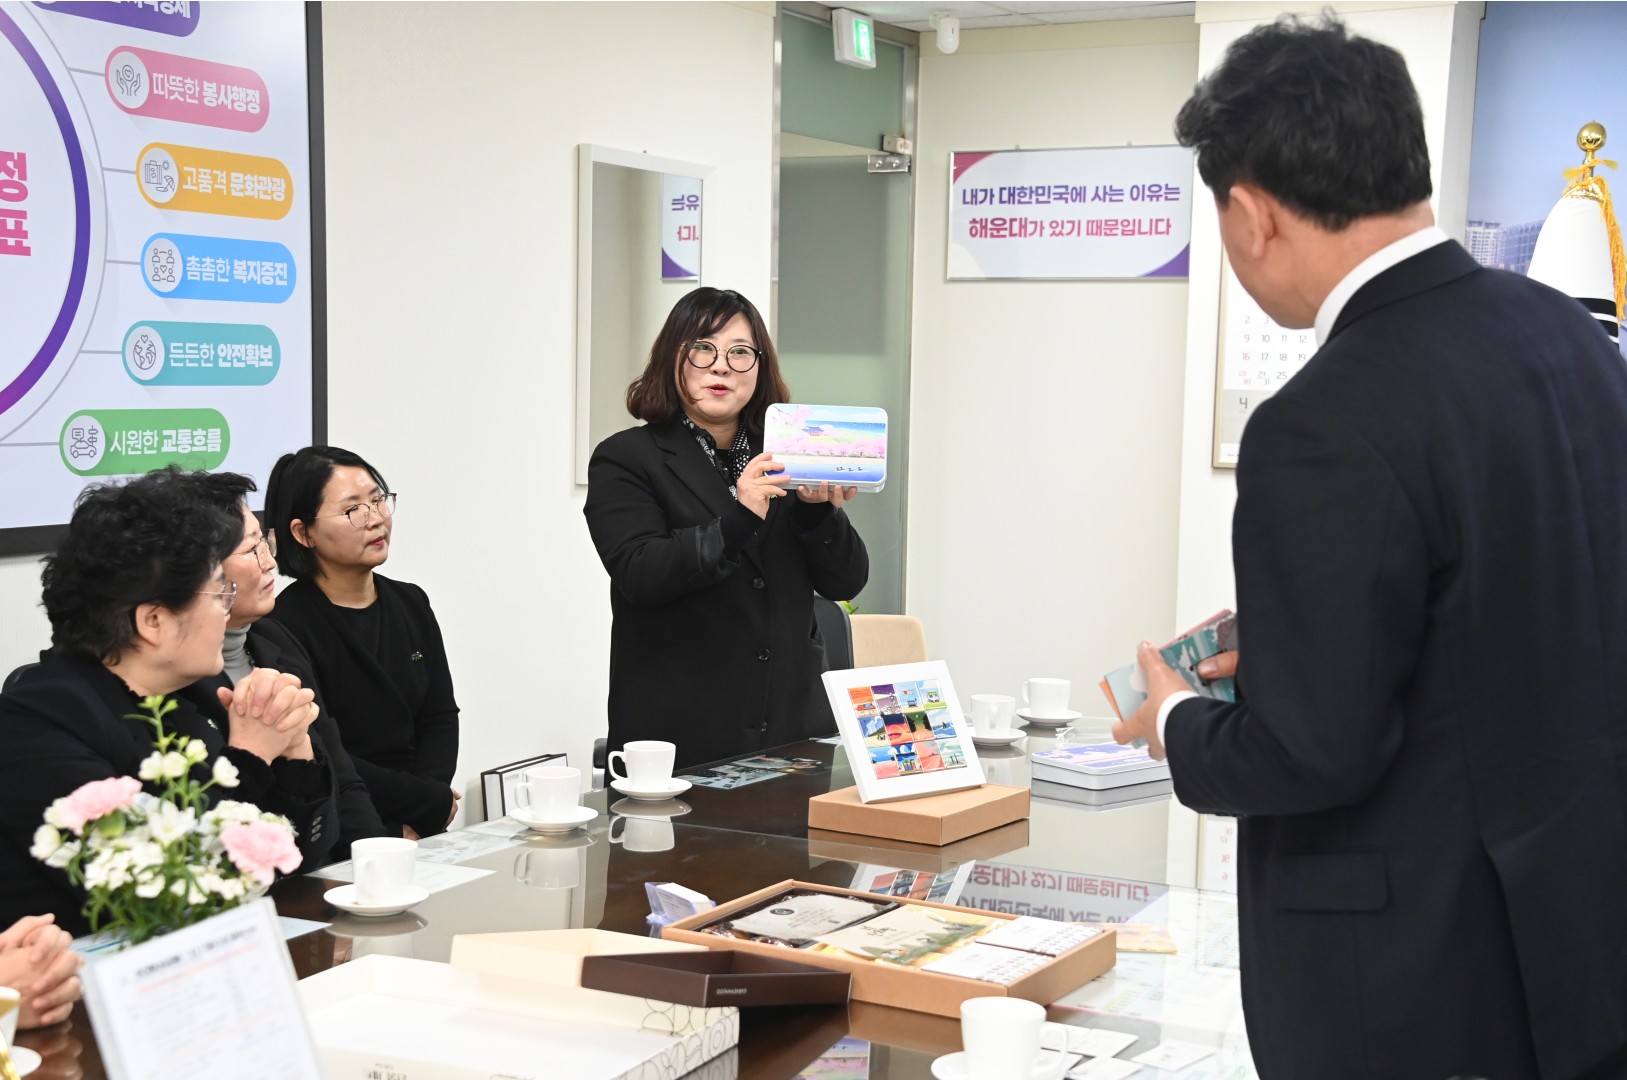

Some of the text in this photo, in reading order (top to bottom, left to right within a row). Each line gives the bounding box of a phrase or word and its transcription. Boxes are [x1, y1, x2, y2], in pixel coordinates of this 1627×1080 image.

[152, 71, 261, 114] 따뜻한 봉사행정
[182, 166, 286, 202] 고품격 문화관광
[962, 183, 1181, 205] 내가 대한민국에 사는 이유는
[968, 217, 1172, 239] 해운대가 있기 때문입니다
[185, 255, 289, 287] 촘촘한 복지증진
[1244, 334, 1307, 344] 9 10 11 12
[169, 342, 273, 368] 든든한 안전확보
[1241, 352, 1306, 362] 16 17 18 19
[1276, 371, 1288, 380] 25
[1239, 397, 1248, 410] 4
[109, 428, 222, 455] 시원한 교통흐름
